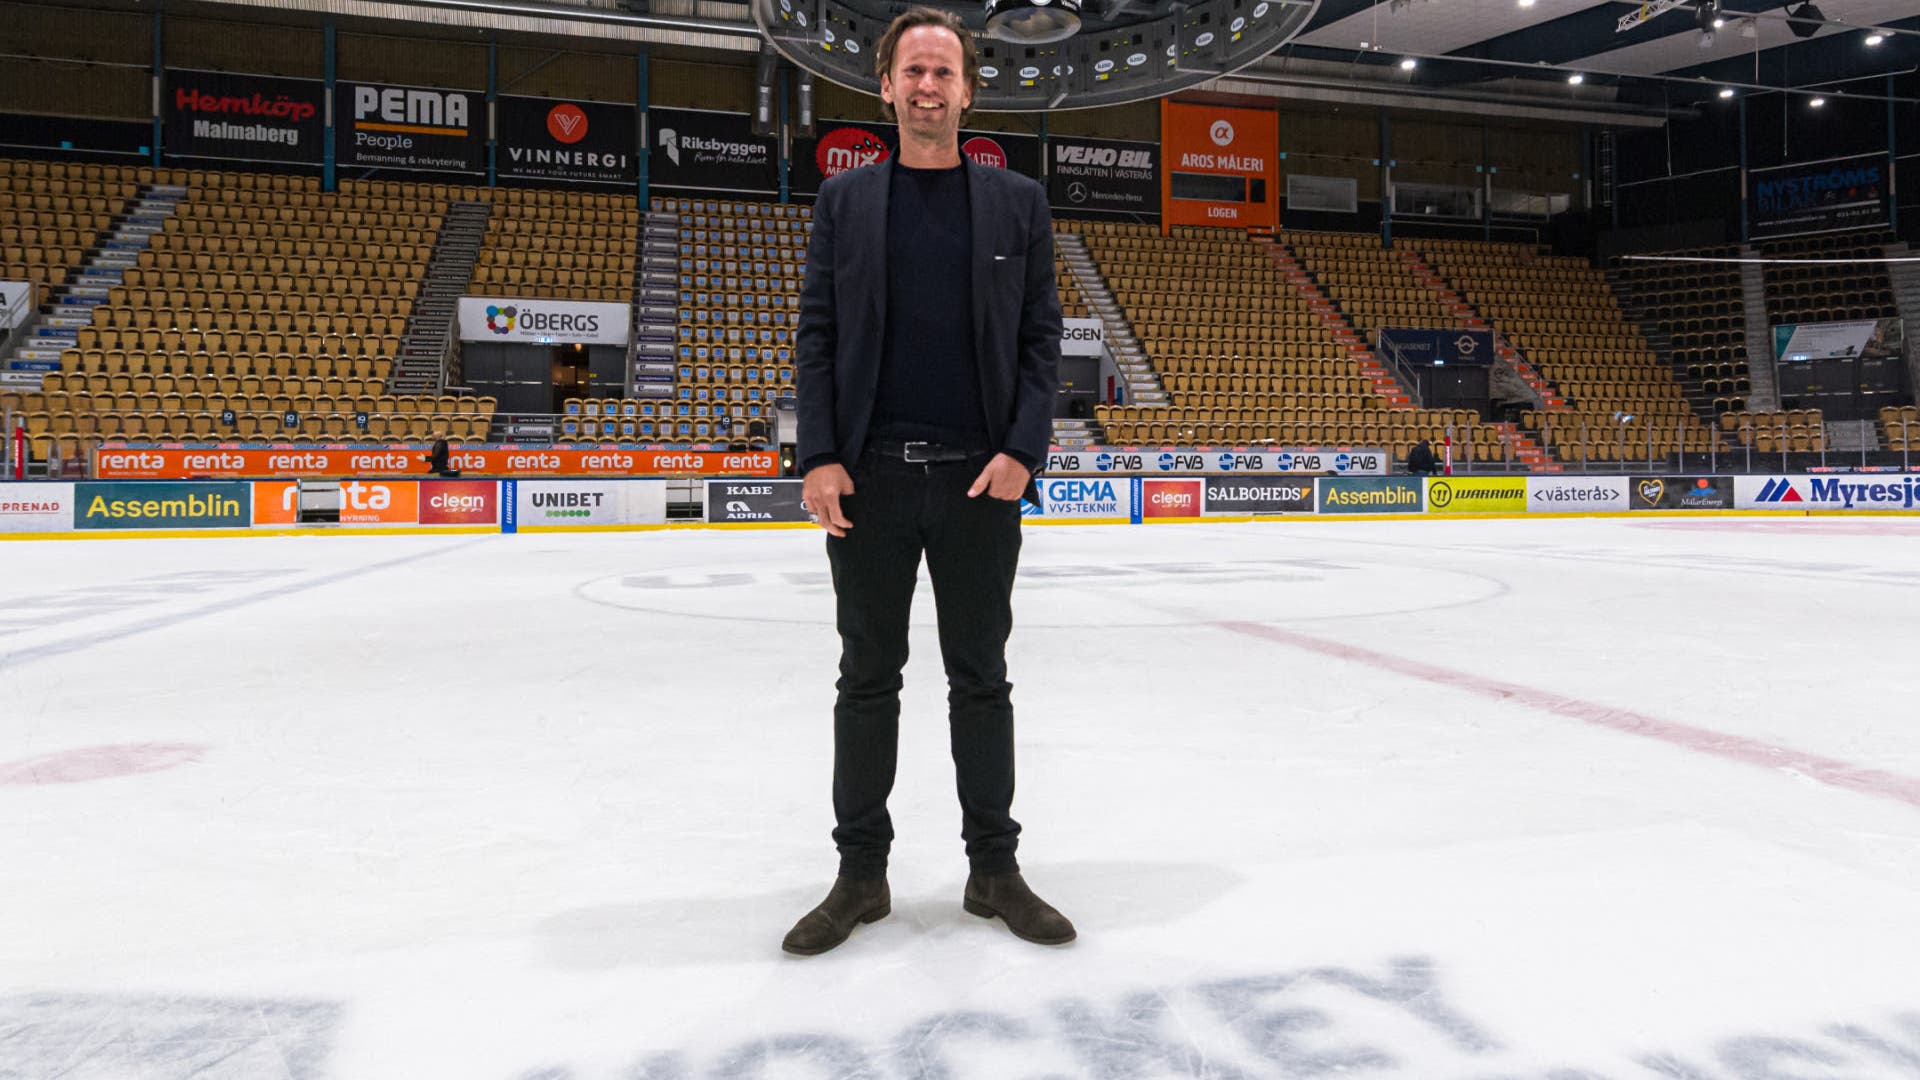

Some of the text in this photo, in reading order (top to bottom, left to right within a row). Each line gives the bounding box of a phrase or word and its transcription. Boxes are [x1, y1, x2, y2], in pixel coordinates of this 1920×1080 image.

[176, 88, 315, 122] Hemköp
[355, 86, 468, 126] PEMA
[193, 120, 299, 146] Malmaberg
[355, 132, 413, 150] People
[681, 136, 767, 155] Riksbyggen
[356, 152, 467, 168] Bemanning & rekrytering
[508, 147, 626, 169] VINNERGI
[1056, 145, 1153, 169] VEHO BIL
[1181, 153, 1264, 173] AROS MÅLERI
[1207, 206, 1238, 219] LOGEN
[519, 308, 600, 333] ÖBERGS
[101, 452, 165, 470] renta
[183, 452, 245, 470] renta
[268, 453, 329, 470] renta
[351, 453, 409, 470] renta
[507, 453, 561, 469] renta
[581, 453, 634, 469] renta
[653, 453, 704, 469] renta
[723, 453, 772, 469] renta
[1049, 455, 1081, 471] FVB
[1112, 455, 1143, 471] FVB
[1174, 455, 1204, 471] FVB
[1234, 455, 1263, 470] FVB
[1293, 455, 1322, 470] FVB
[1350, 456, 1378, 470] FVB
[282, 480, 391, 511] rta
[726, 486, 773, 496] KABE
[1048, 480, 1117, 503] GEMA
[1151, 490, 1191, 505] clean
[1207, 486, 1302, 501] SALBOHEDS
[1326, 486, 1417, 506] Assemblin
[1454, 488, 1525, 500] WARRIOR
[85, 493, 240, 519] Assemblin
[430, 492, 485, 509] clean
[532, 492, 604, 508] UNIBET
[1049, 502, 1117, 514] VVS-TEKNIK
[726, 512, 773, 520] ADRIA
